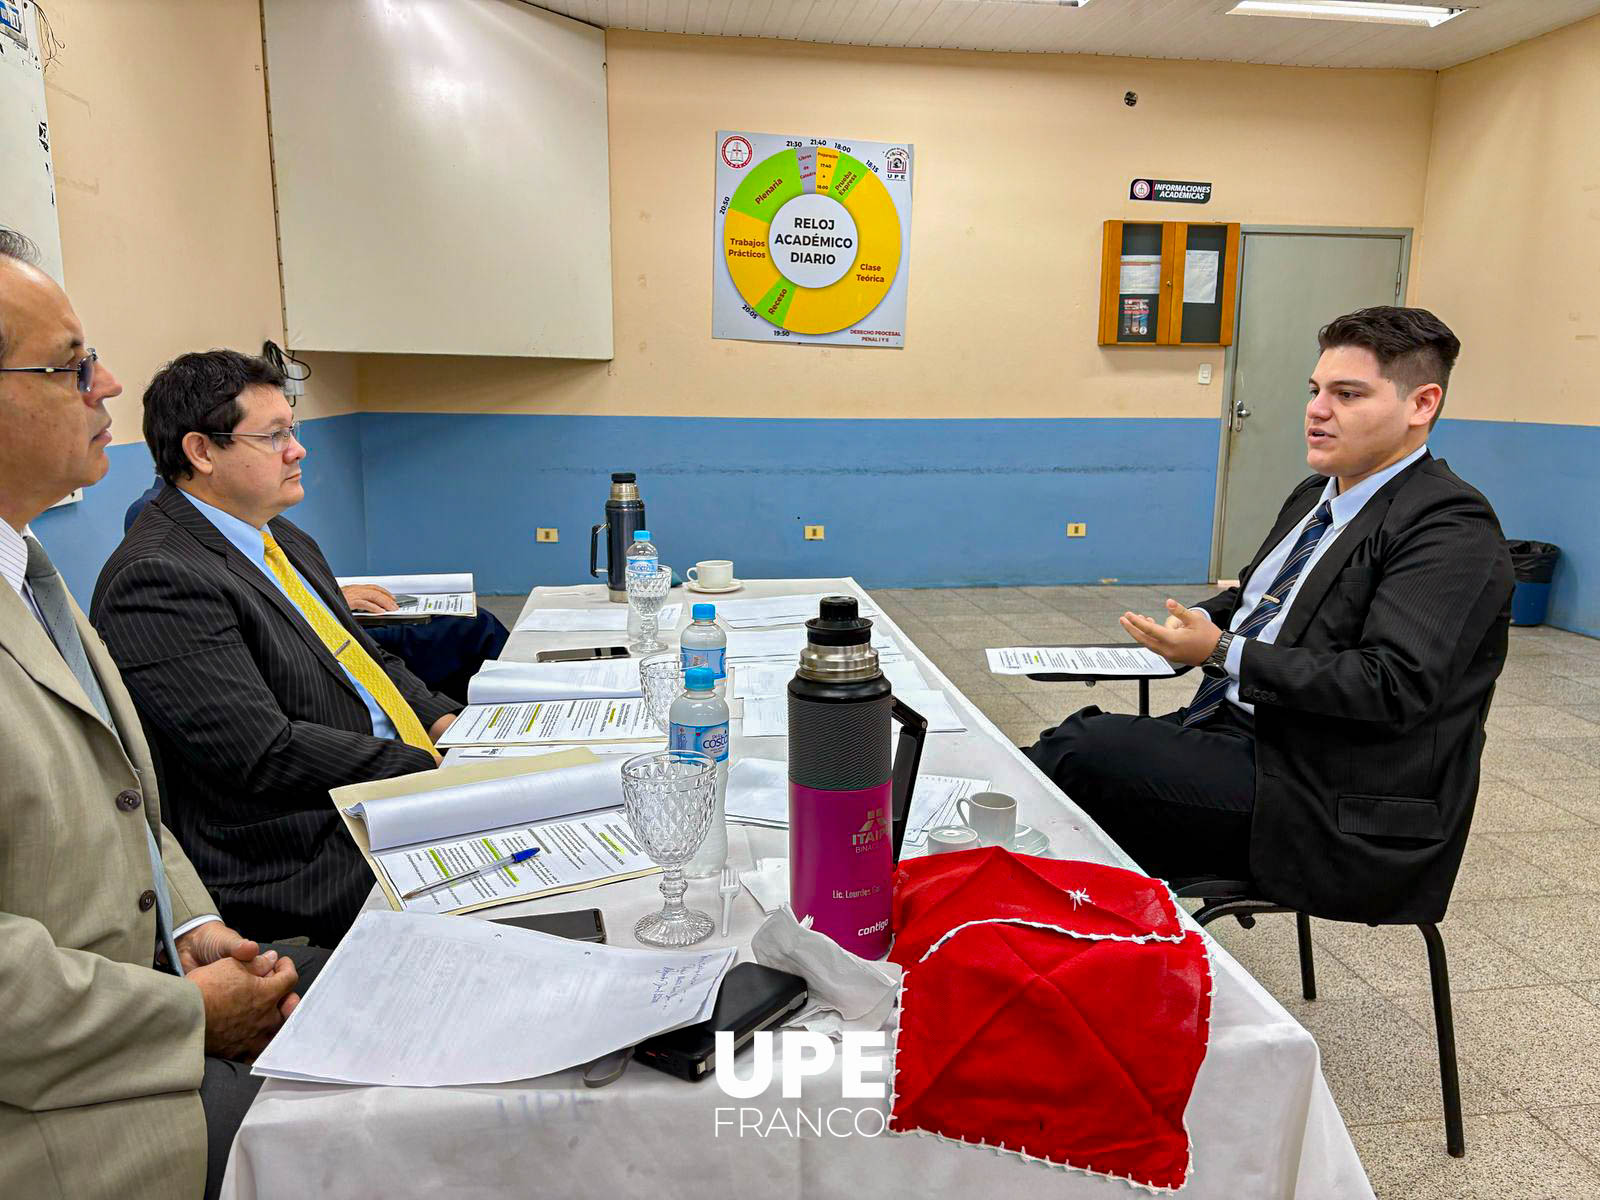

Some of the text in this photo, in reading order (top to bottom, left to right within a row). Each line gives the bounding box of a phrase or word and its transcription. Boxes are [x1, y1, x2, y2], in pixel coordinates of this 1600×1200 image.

[834, 142, 851, 153] 18:00
[865, 160, 879, 173] 18:15
[834, 171, 852, 191] Prueba
[838, 174, 858, 196] Express
[754, 178, 783, 205] Plenaria
[1154, 183, 1211, 194] INFORMACIONES
[1159, 190, 1205, 200] ACADÉMICAS
[719, 196, 730, 215] 20:50
[794, 217, 835, 231] RELOJ
[730, 237, 766, 248] Trabajos
[774, 232, 853, 249] ACADÉMICO
[728, 249, 766, 258] Prácticos
[790, 252, 836, 265] DIARIO
[860, 263, 882, 272] Clase
[856, 273, 885, 283] Teórica
[768, 288, 788, 315] Receso
[741, 303, 758, 319] 20:05
[852, 827, 888, 846] ITAIP
[845, 888, 871, 898] Lourdes
[857, 918, 889, 937] contigo
